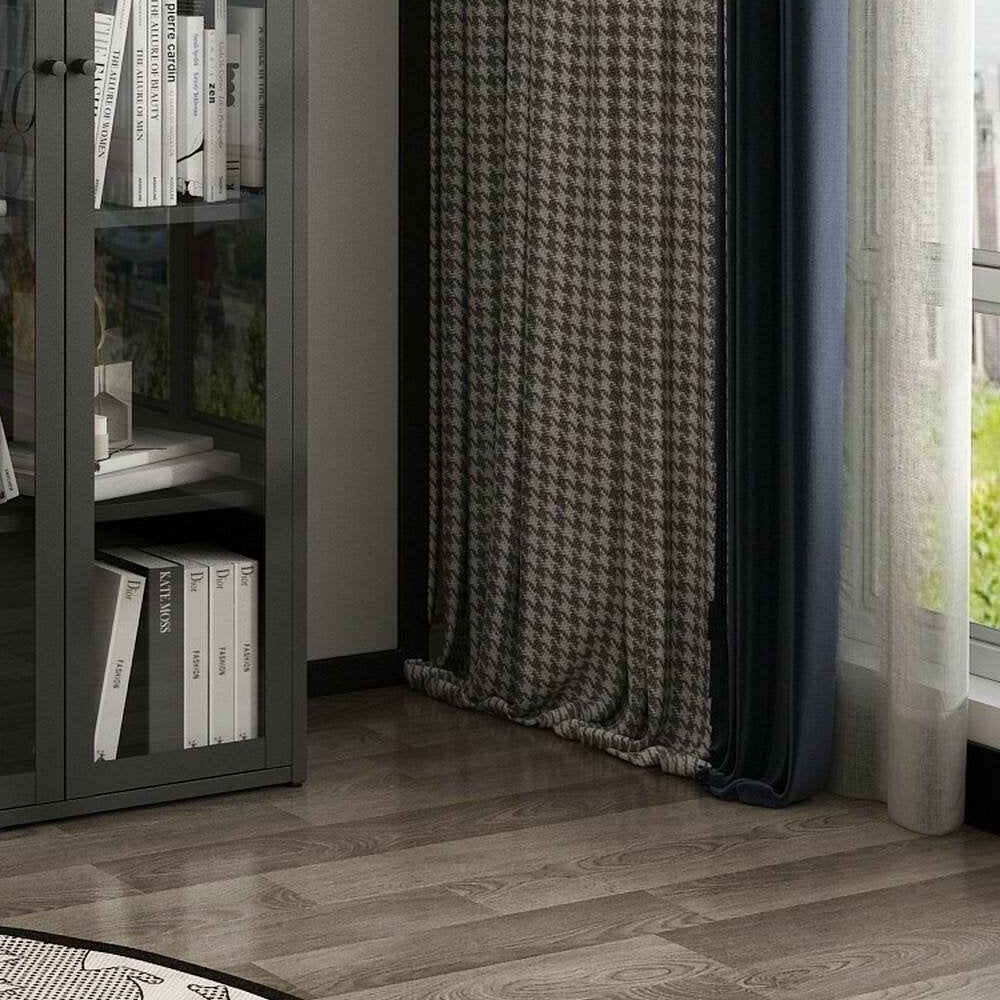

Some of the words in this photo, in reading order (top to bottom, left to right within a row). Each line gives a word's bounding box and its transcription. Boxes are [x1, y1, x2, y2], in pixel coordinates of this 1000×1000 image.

[151, 0, 159, 19] THE
[165, 3, 176, 43] pierre
[151, 21, 159, 61] ALLURE
[112, 51, 121, 66] THE
[136, 49, 144, 65] THE
[167, 47, 176, 83] cardin
[151, 63, 159, 78] OF
[105, 67, 117, 104] ALLURE
[136, 67, 144, 104] ALLURE
[151, 79, 159, 121] BEAUTY
[103, 106, 111, 120] OF
[136, 105, 144, 119] OF
[97, 121, 109, 158] WOMEN
[136, 120, 144, 141] MEN
[159, 571, 172, 600] KATE
[190, 572, 204, 592] Dior
[216, 569, 230, 589] Dior
[241, 566, 254, 586] Dior
[125, 580, 140, 600] Dior
[159, 600, 172, 634] MOSS
[113, 659, 124, 689] FASHION
